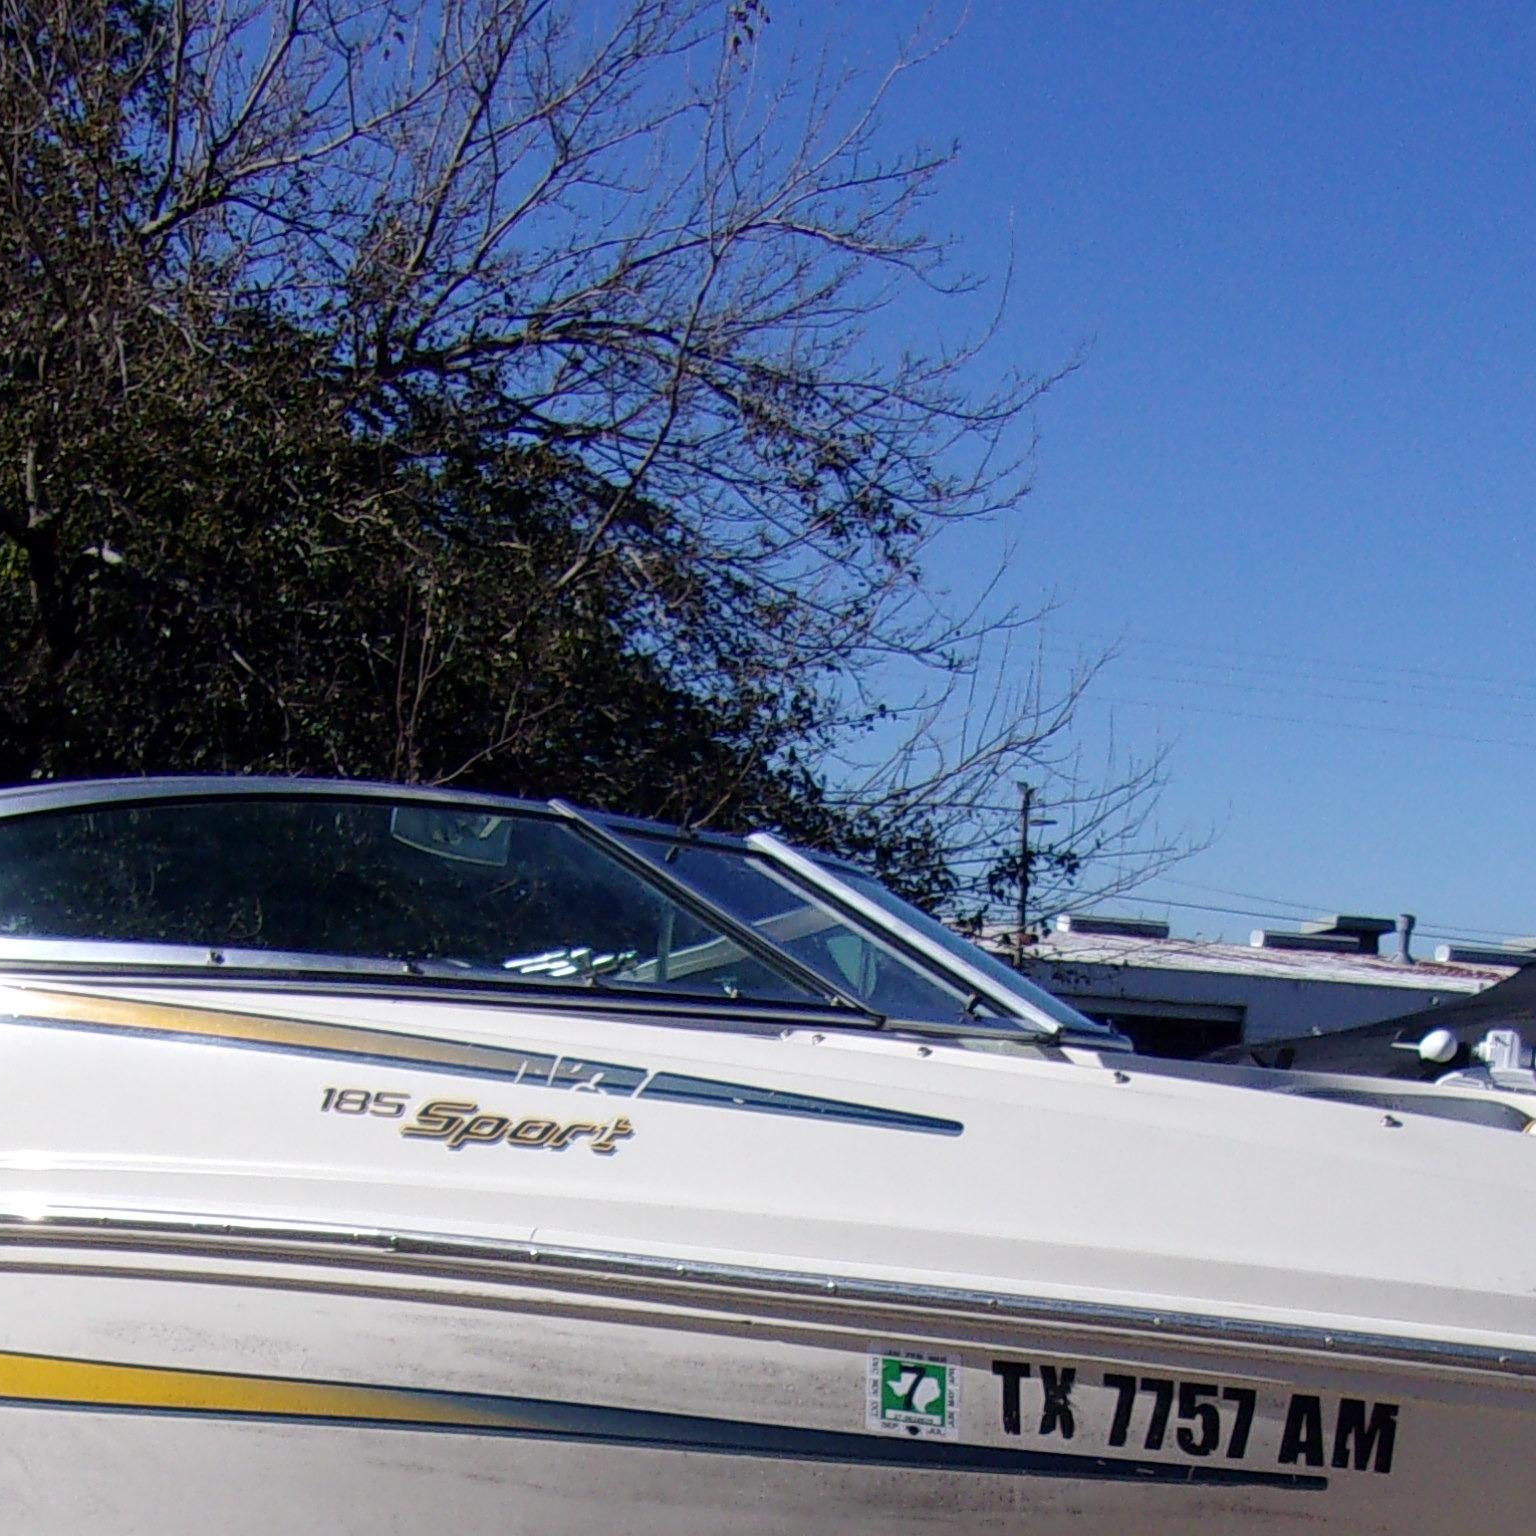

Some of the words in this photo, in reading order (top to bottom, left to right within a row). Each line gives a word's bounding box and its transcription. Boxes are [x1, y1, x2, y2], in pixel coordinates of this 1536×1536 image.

[320, 1088, 411, 1117] 185
[400, 1097, 635, 1155] Sport
[899, 1364, 926, 1410] 7
[992, 1360, 1077, 1439] TX
[1103, 1373, 1256, 1460] 7757
[1277, 1393, 1400, 1474] AM
